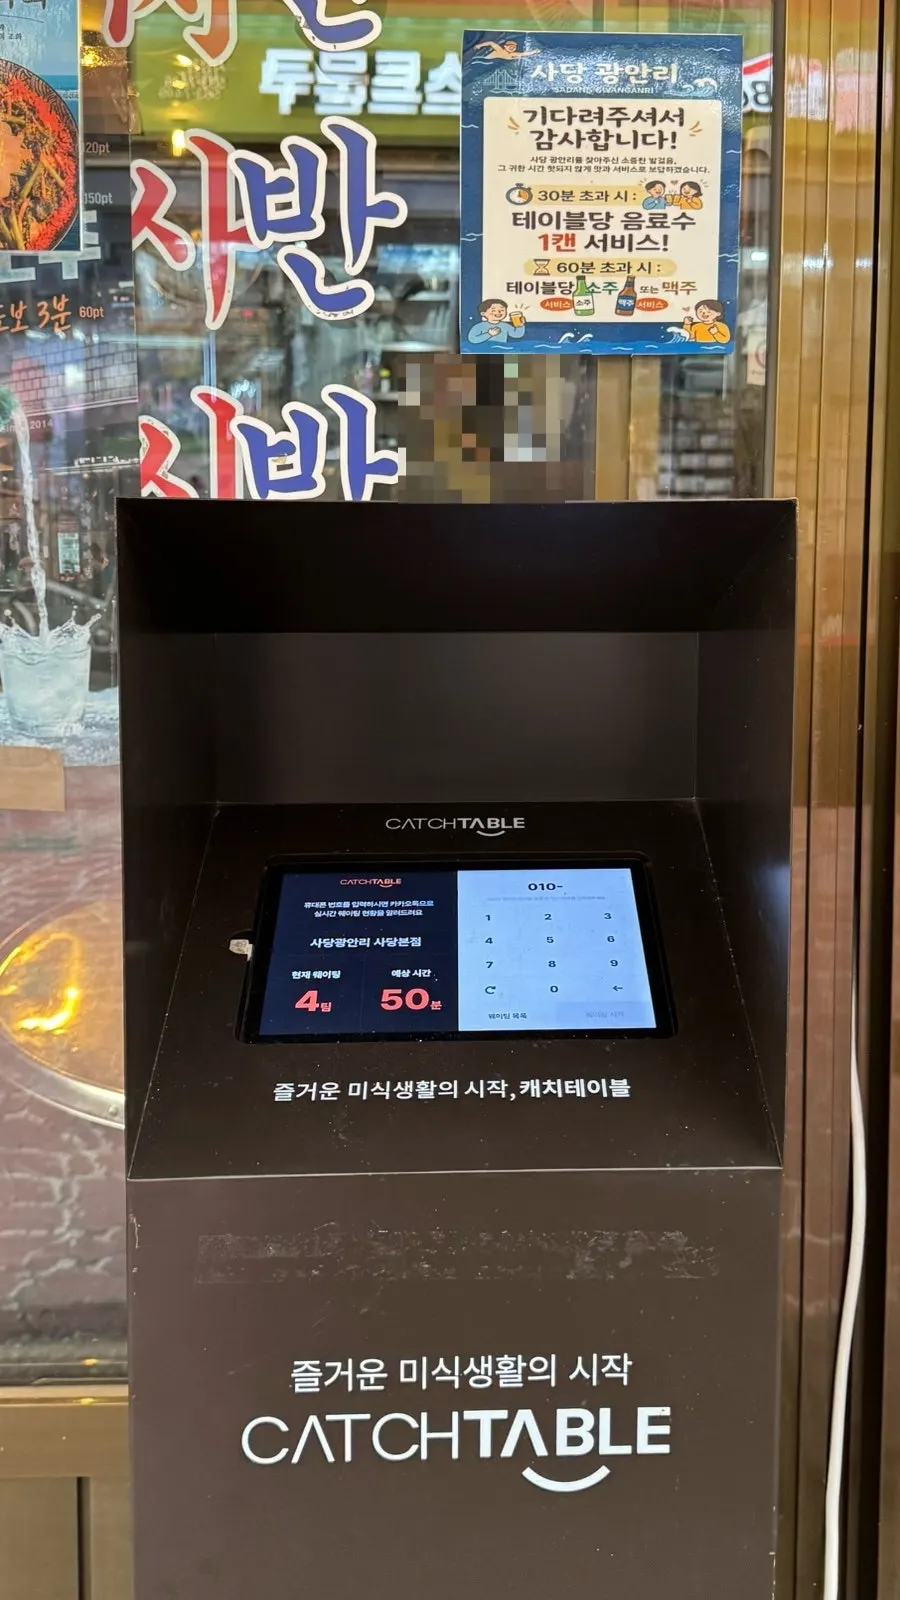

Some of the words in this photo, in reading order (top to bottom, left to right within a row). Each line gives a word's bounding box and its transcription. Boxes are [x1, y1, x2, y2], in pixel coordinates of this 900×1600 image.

[530, 62, 585, 85] 사당
[596, 62, 679, 85] 광안리
[523, 105, 685, 128] 기다려주셔서
[529, 128, 677, 151] 감사합니다!
[82, 141, 111, 155] 20pt
[530, 156, 548, 164] 사당
[549, 156, 583, 165] 광안리를
[586, 156, 619, 165] 찾아주신
[621, 156, 646, 165] 소중한
[497, 164, 507, 172] 그
[509, 164, 526, 173] 귀한
[528, 165, 545, 173] 시간
[594, 165, 611, 173] 맛과
[613, 165, 647, 174] 서비스로
[649, 166, 711, 174] 보답하겠습니다.
[537, 190, 575, 202] 30분
[579, 190, 610, 202] 초과
[613, 190, 629, 202] 시
[512, 211, 614, 231] 테이블당
[620, 211, 696, 231] 음료수
[538, 233, 576, 252] 1캔
[584, 233, 669, 253] 서비스!
[556, 261, 596, 274] 60분
[599, 261, 632, 274] 초과
[636, 261, 652, 274] 시
[506, 281, 575, 296] 테이블당
[586, 281, 619, 295] 소주
[639, 285, 659, 295] 또는
[662, 281, 698, 296] 맥주
[544, 300, 572, 309] 서비스
[575, 299, 591, 307] 소주
[618, 298, 634, 307] 맥주
[637, 300, 665, 309] 서비스
[37, 294, 72, 334] 3분
[79, 306, 105, 319] 60pt
[29, 418, 54, 430] 2014
[385, 816, 526, 831] CATCHTABLE
[339, 878, 402, 887] CATCHTABLE
[527, 882, 563, 891] 010-
[304, 901, 327, 909] 휴대폰
[328, 901, 351, 909] 번호를
[390, 900, 435, 908] 카카오톡으로
[314, 910, 337, 918] 실시간
[338, 910, 361, 918] 웨이팅
[362, 909, 385, 917] 현황을
[386, 909, 424, 917] 알려드려요
[544, 913, 552, 921] 2
[604, 912, 612, 920] 3
[310, 937, 371, 948] 사당광안리
[373, 936, 422, 948] 사당본점
[546, 936, 554, 944] 5
[607, 935, 615, 943] 6
[485, 961, 494, 969] 7
[548, 960, 556, 968] 8
[610, 959, 618, 967] 9
[291, 970, 311, 980] 현재
[312, 970, 341, 979] 웨이팅
[391, 969, 411, 978] 예상
[411, 969, 432, 978] 시간
[550, 985, 559, 993] 0
[295, 990, 332, 1013] 4팀
[380, 988, 443, 1011] 50분
[488, 1012, 510, 1020] 웨이팅
[273, 1082, 341, 1102] 즐거운
[348, 1080, 459, 1101] 미식생활의
[465, 1078, 517, 1101] 시작,
[519, 1077, 632, 1100] 캐치테이블
[290, 1358, 389, 1394] 즐거운
[399, 1354, 558, 1391] 미식생활의
[568, 1353, 633, 1388] 시작
[241, 1406, 672, 1468] CATCHTABLE
